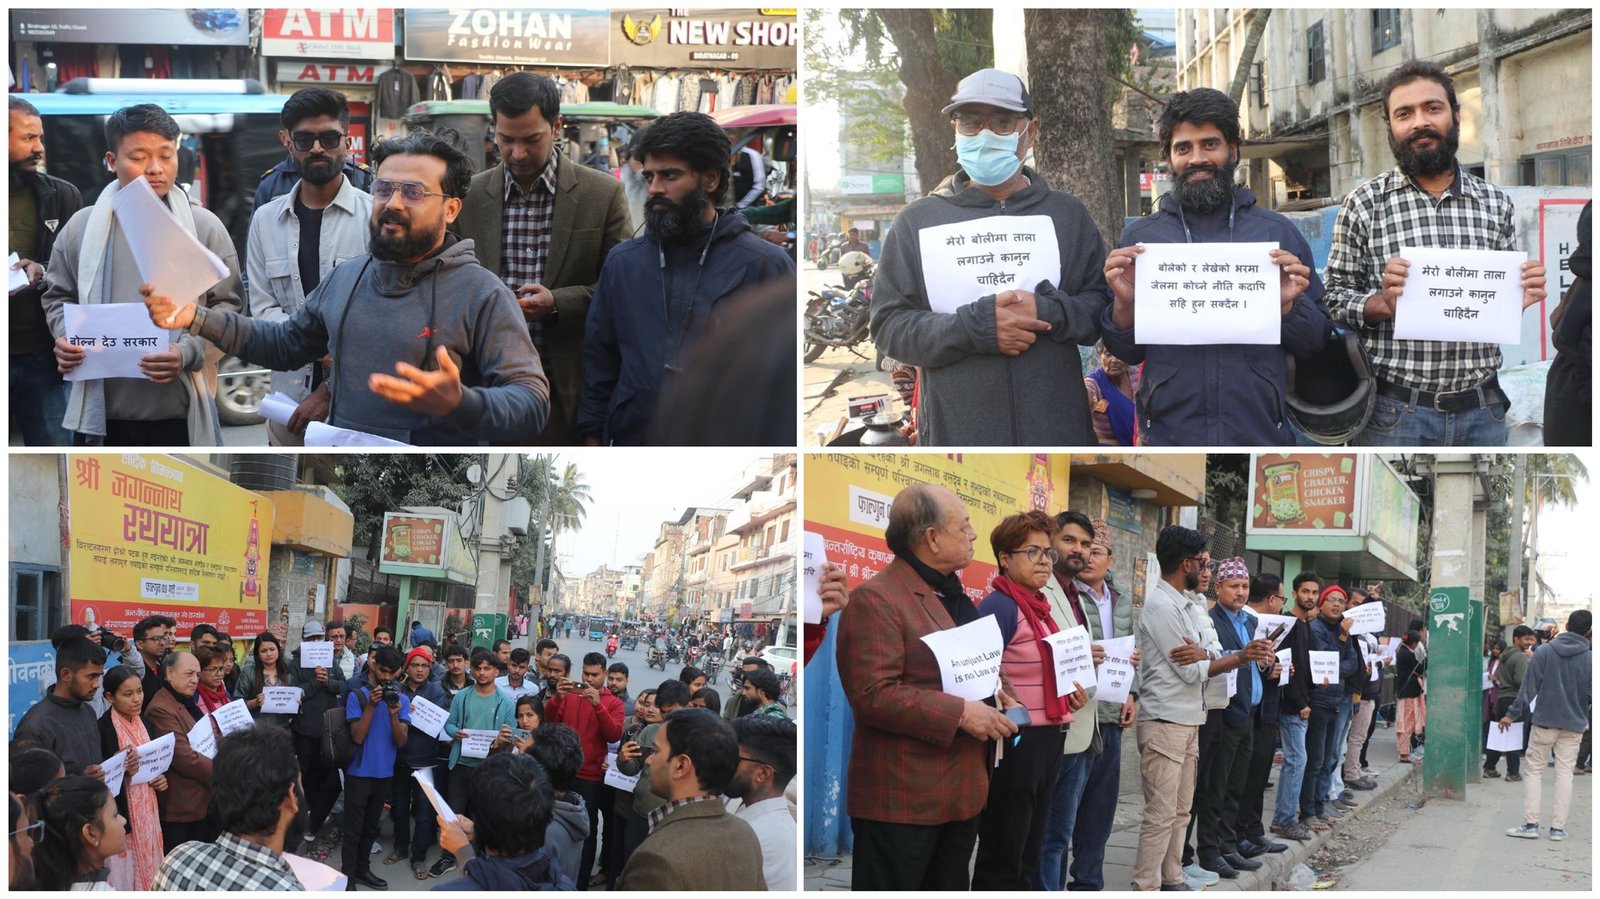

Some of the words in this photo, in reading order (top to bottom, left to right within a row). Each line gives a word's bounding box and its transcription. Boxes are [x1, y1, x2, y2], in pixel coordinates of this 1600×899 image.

[280, 8, 378, 38] ATM
[448, 8, 572, 39] ZOHAN
[670, 20, 730, 45] NEW
[448, 34, 523, 49] Fashion
[297, 64, 375, 82] ATM
[946, 234, 965, 246] मेरो
[972, 232, 1008, 244] बोलीमा
[1013, 233, 1036, 243] ताला
[956, 252, 994, 266] लगाउने
[1000, 252, 1030, 266] कानुन
[1158, 262, 1187, 273] बोलेको
[1192, 265, 1197, 273] र
[1202, 262, 1230, 273] लेखेको
[1235, 264, 1259, 273] भरमा
[1422, 264, 1440, 277] मेरो
[1445, 266, 1478, 279] बोलीमा
[1483, 270, 1506, 280] ताला
[976, 272, 1016, 286] चाहिदैन
[1151, 280, 1178, 290] जेलमा
[1182, 280, 1208, 290] कोच्ने
[1212, 280, 1233, 291] नीति
[1238, 280, 1266, 292] कदापि
[1428, 286, 1463, 298] लगाउने
[1468, 289, 1497, 304] कानुन
[1169, 297, 1187, 308] सहि
[1192, 299, 1206, 313] हुन
[1210, 298, 1239, 309] सक्दैन
[1443, 307, 1480, 320] चाहिदैन
[69, 334, 96, 347] बोल्न
[102, 335, 117, 347] देउ
[122, 337, 158, 347] सरकार
[900, 454, 909, 468] श्री
[1303, 466, 1336, 478] CRISPY
[75, 457, 101, 491] श्री
[112, 469, 184, 513] जगन्नाथ
[1303, 476, 1349, 488] CRACKER,
[1303, 486, 1344, 498] CHICKEN
[858, 495, 885, 521] फाल्गुन
[1304, 496, 1346, 507] SNACKER
[123, 503, 210, 555] रथयात्रा
[961, 655, 983, 666] unjust
[983, 649, 1001, 661] Law
[954, 674, 963, 683] is
[965, 673, 975, 681] no
[974, 669, 990, 678] Law
[990, 665, 998, 673] at
